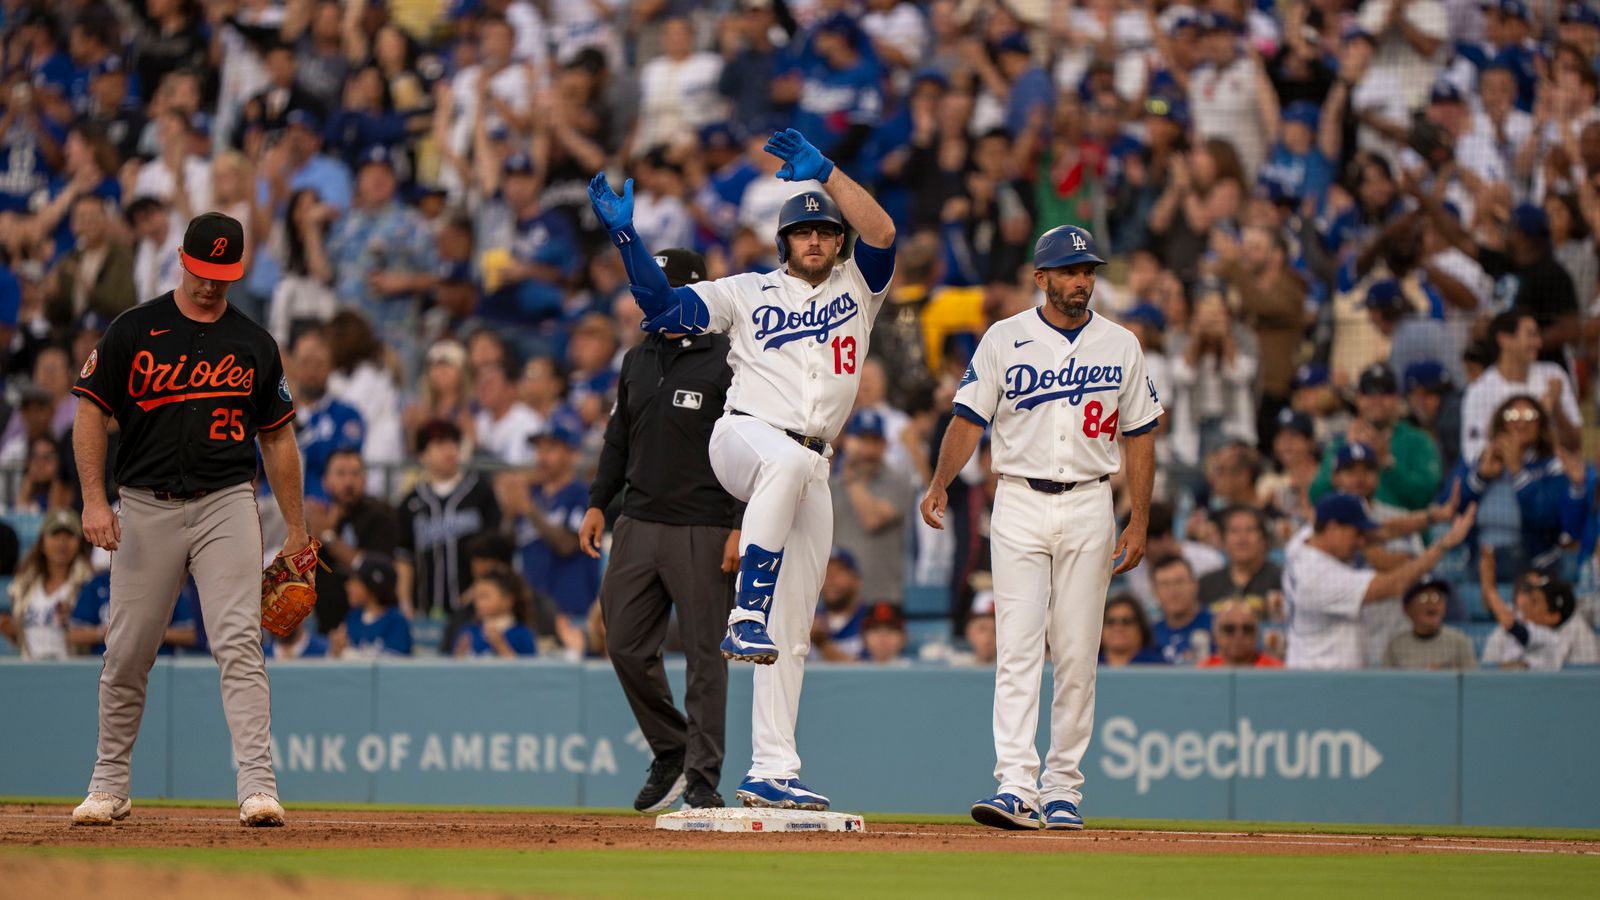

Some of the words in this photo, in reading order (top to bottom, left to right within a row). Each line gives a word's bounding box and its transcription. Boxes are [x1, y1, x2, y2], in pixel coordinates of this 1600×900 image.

[804, 194, 820, 212] LA
[210, 237, 228, 257] B
[1070, 232, 1087, 251] LA
[752, 292, 858, 345] Dodgers
[128, 350, 254, 398] Orioles
[831, 336, 856, 375] 13
[1005, 357, 1123, 406] Dodgers
[209, 408, 245, 441] 25
[1082, 400, 1119, 442] 84
[232, 734, 347, 773] ANK
[357, 734, 412, 773] OF
[419, 734, 619, 775] AMERICA
[1101, 716, 1366, 795] Spectrum
